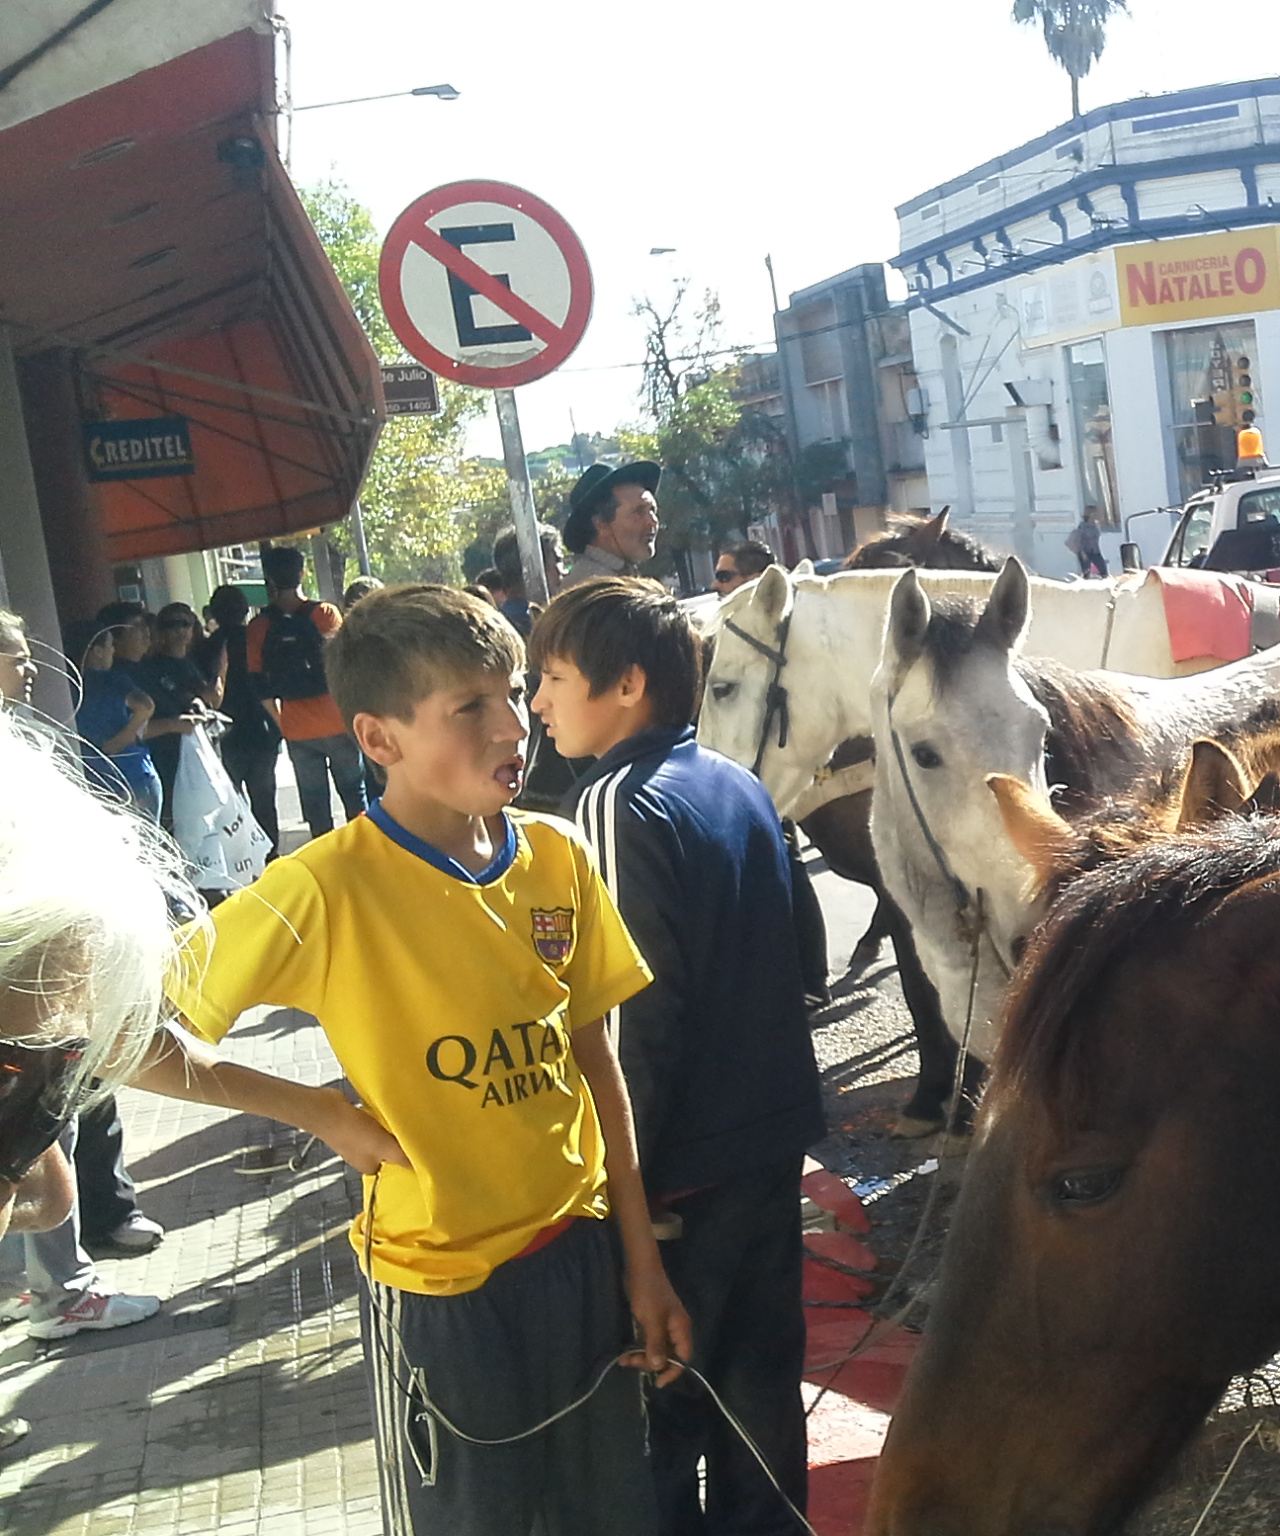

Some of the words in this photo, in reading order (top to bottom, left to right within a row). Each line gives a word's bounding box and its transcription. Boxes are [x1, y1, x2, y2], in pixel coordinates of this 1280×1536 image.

[1126, 247, 1267, 307] NATALEO
[1158, 255, 1230, 276] CARNICERIA
[397, 369, 428, 382] Julio
[90, 435, 187, 463] CREDITEL
[426, 1010, 568, 1090] QATA
